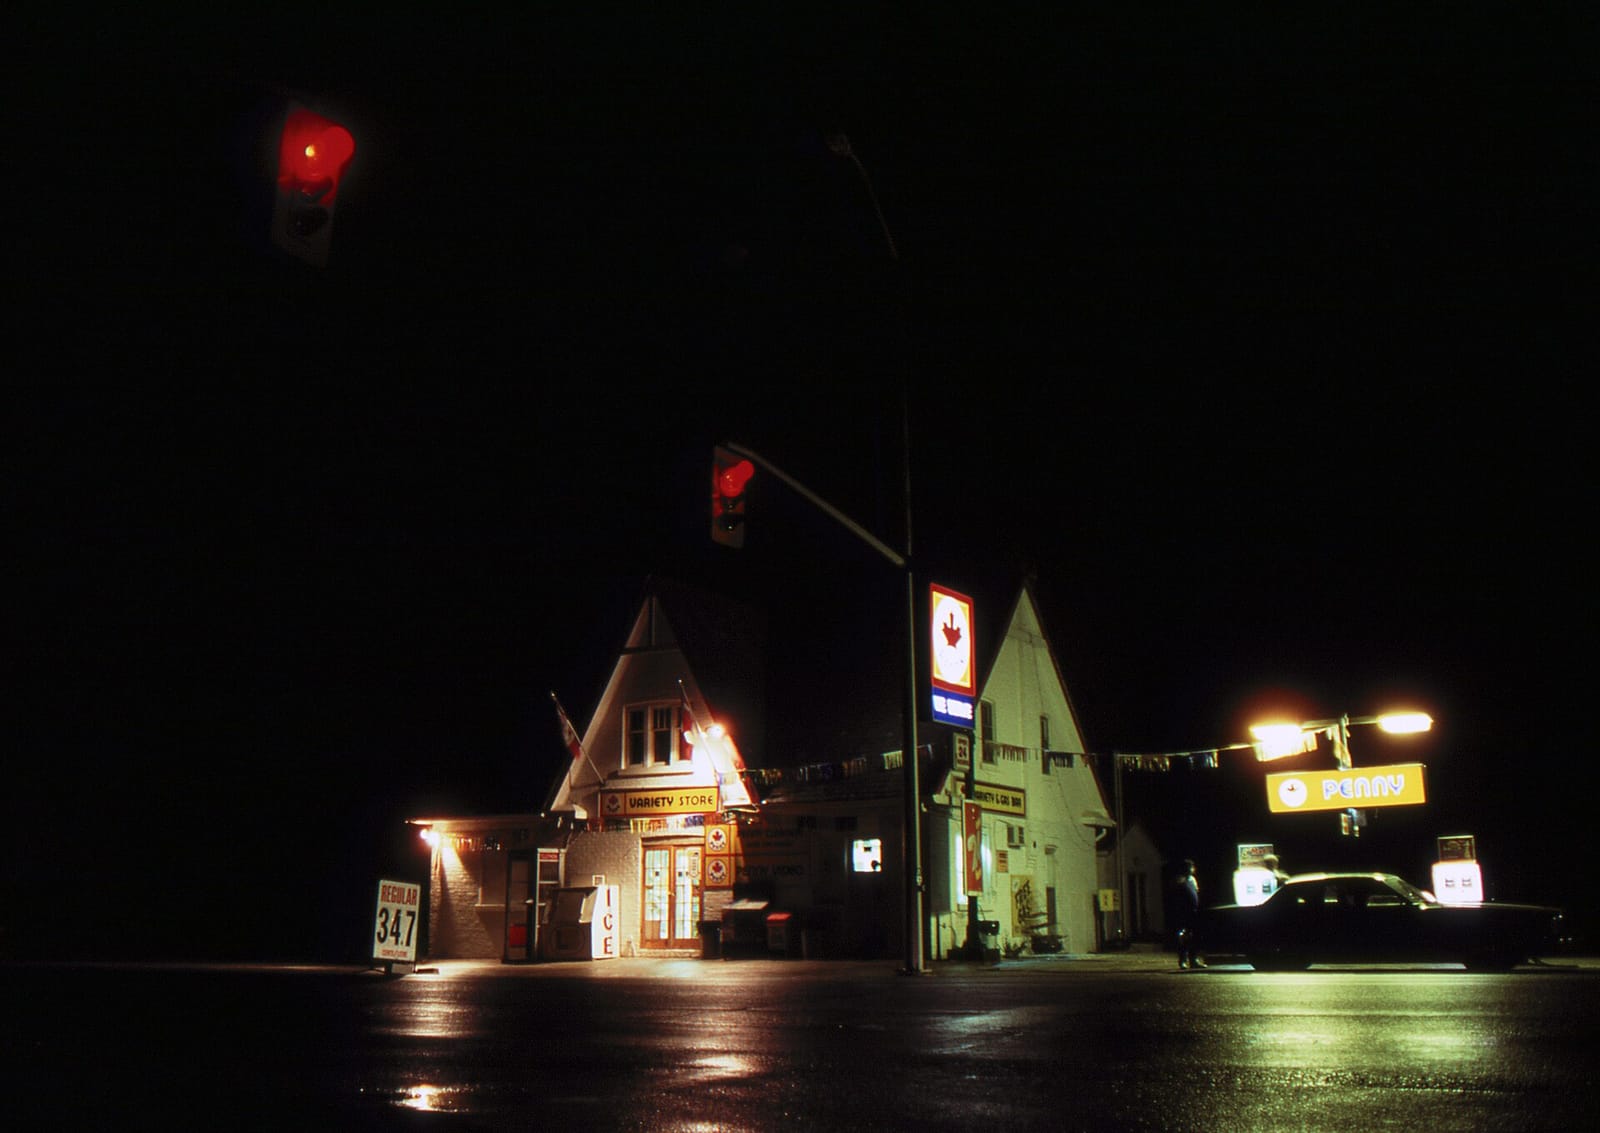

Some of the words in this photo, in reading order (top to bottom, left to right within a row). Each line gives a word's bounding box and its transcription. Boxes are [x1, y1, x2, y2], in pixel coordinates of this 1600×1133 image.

[1322, 774, 1405, 801] PENNY
[629, 796, 675, 809] VARIETY
[679, 795, 714, 806] STORE
[381, 885, 417, 905] REGULAR
[377, 907, 416, 947] 34.7
[602, 887, 614, 956] ICE
